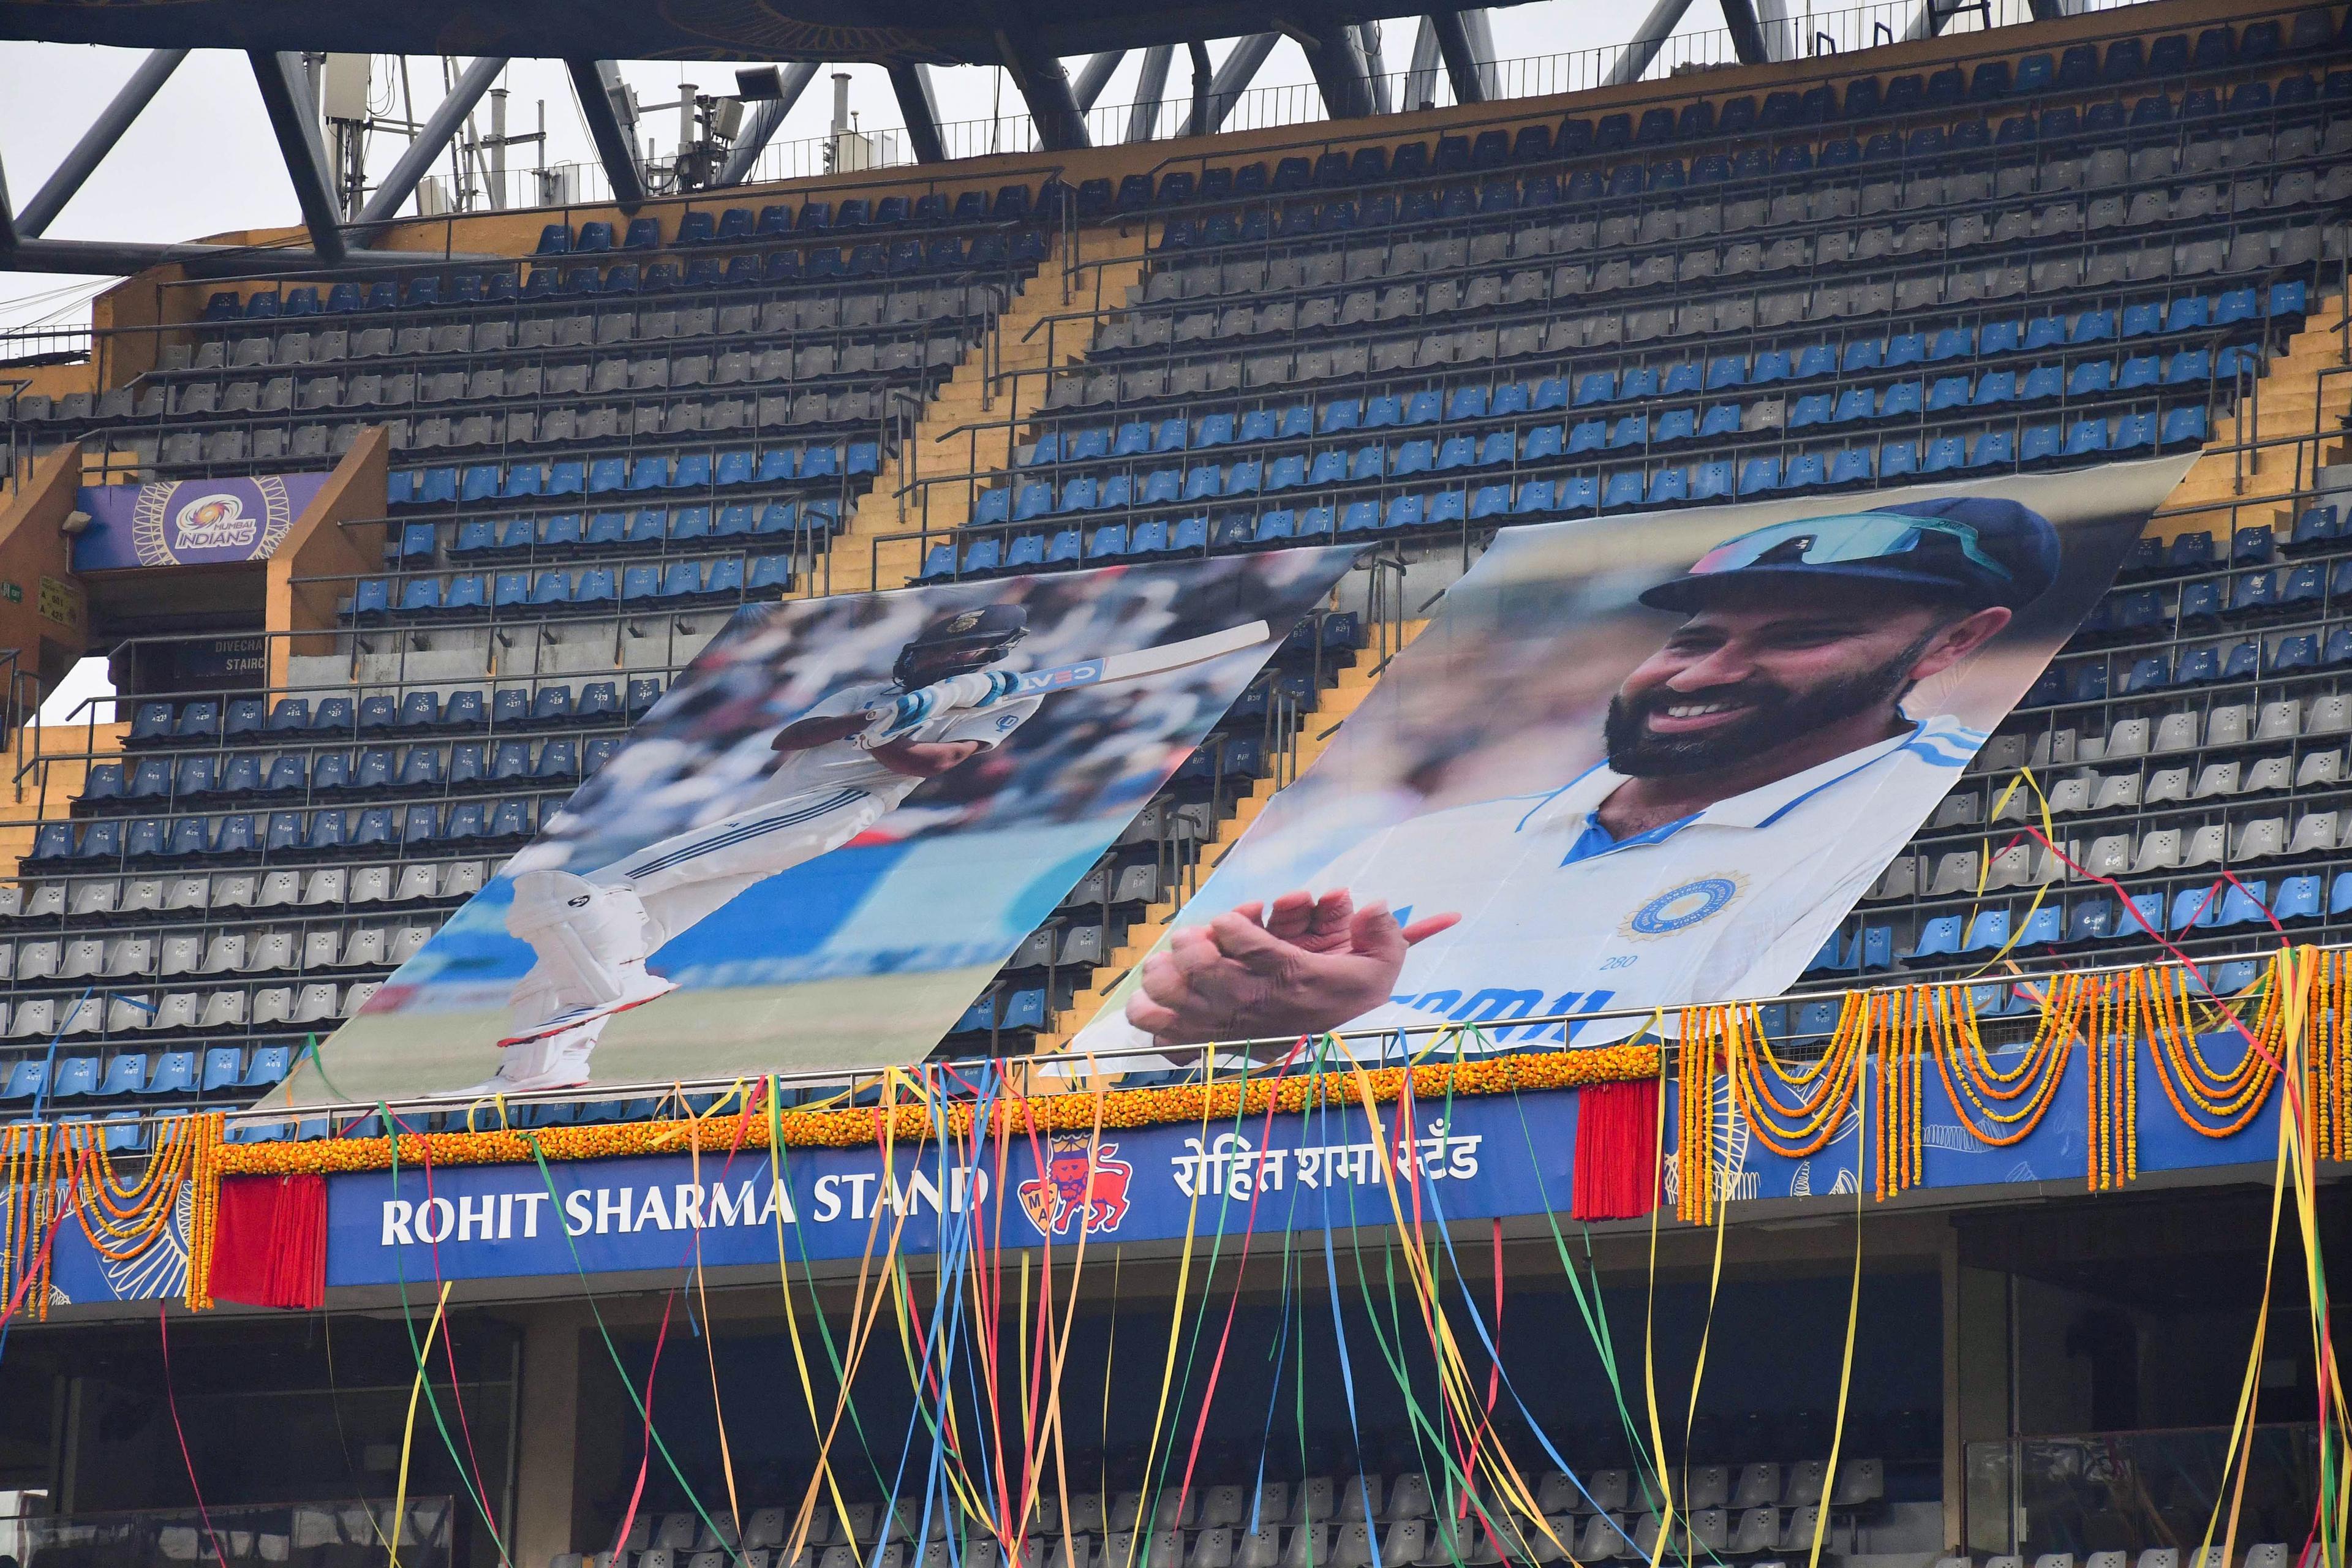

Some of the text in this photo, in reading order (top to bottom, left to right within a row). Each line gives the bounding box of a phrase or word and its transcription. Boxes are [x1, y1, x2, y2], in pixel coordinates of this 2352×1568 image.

[214, 521, 253, 530] MUMBAI
[179, 529, 255, 546] INDIANS
[216, 639, 262, 652] DIVECHA
[1020, 666, 1096, 691] CEAT
[1599, 956, 1638, 971] 280
[1171, 1133, 1288, 1201] रोहित
[1294, 1124, 1385, 1189] शर्मा
[381, 1167, 989, 1246] ROHIT SHARMA STAND
